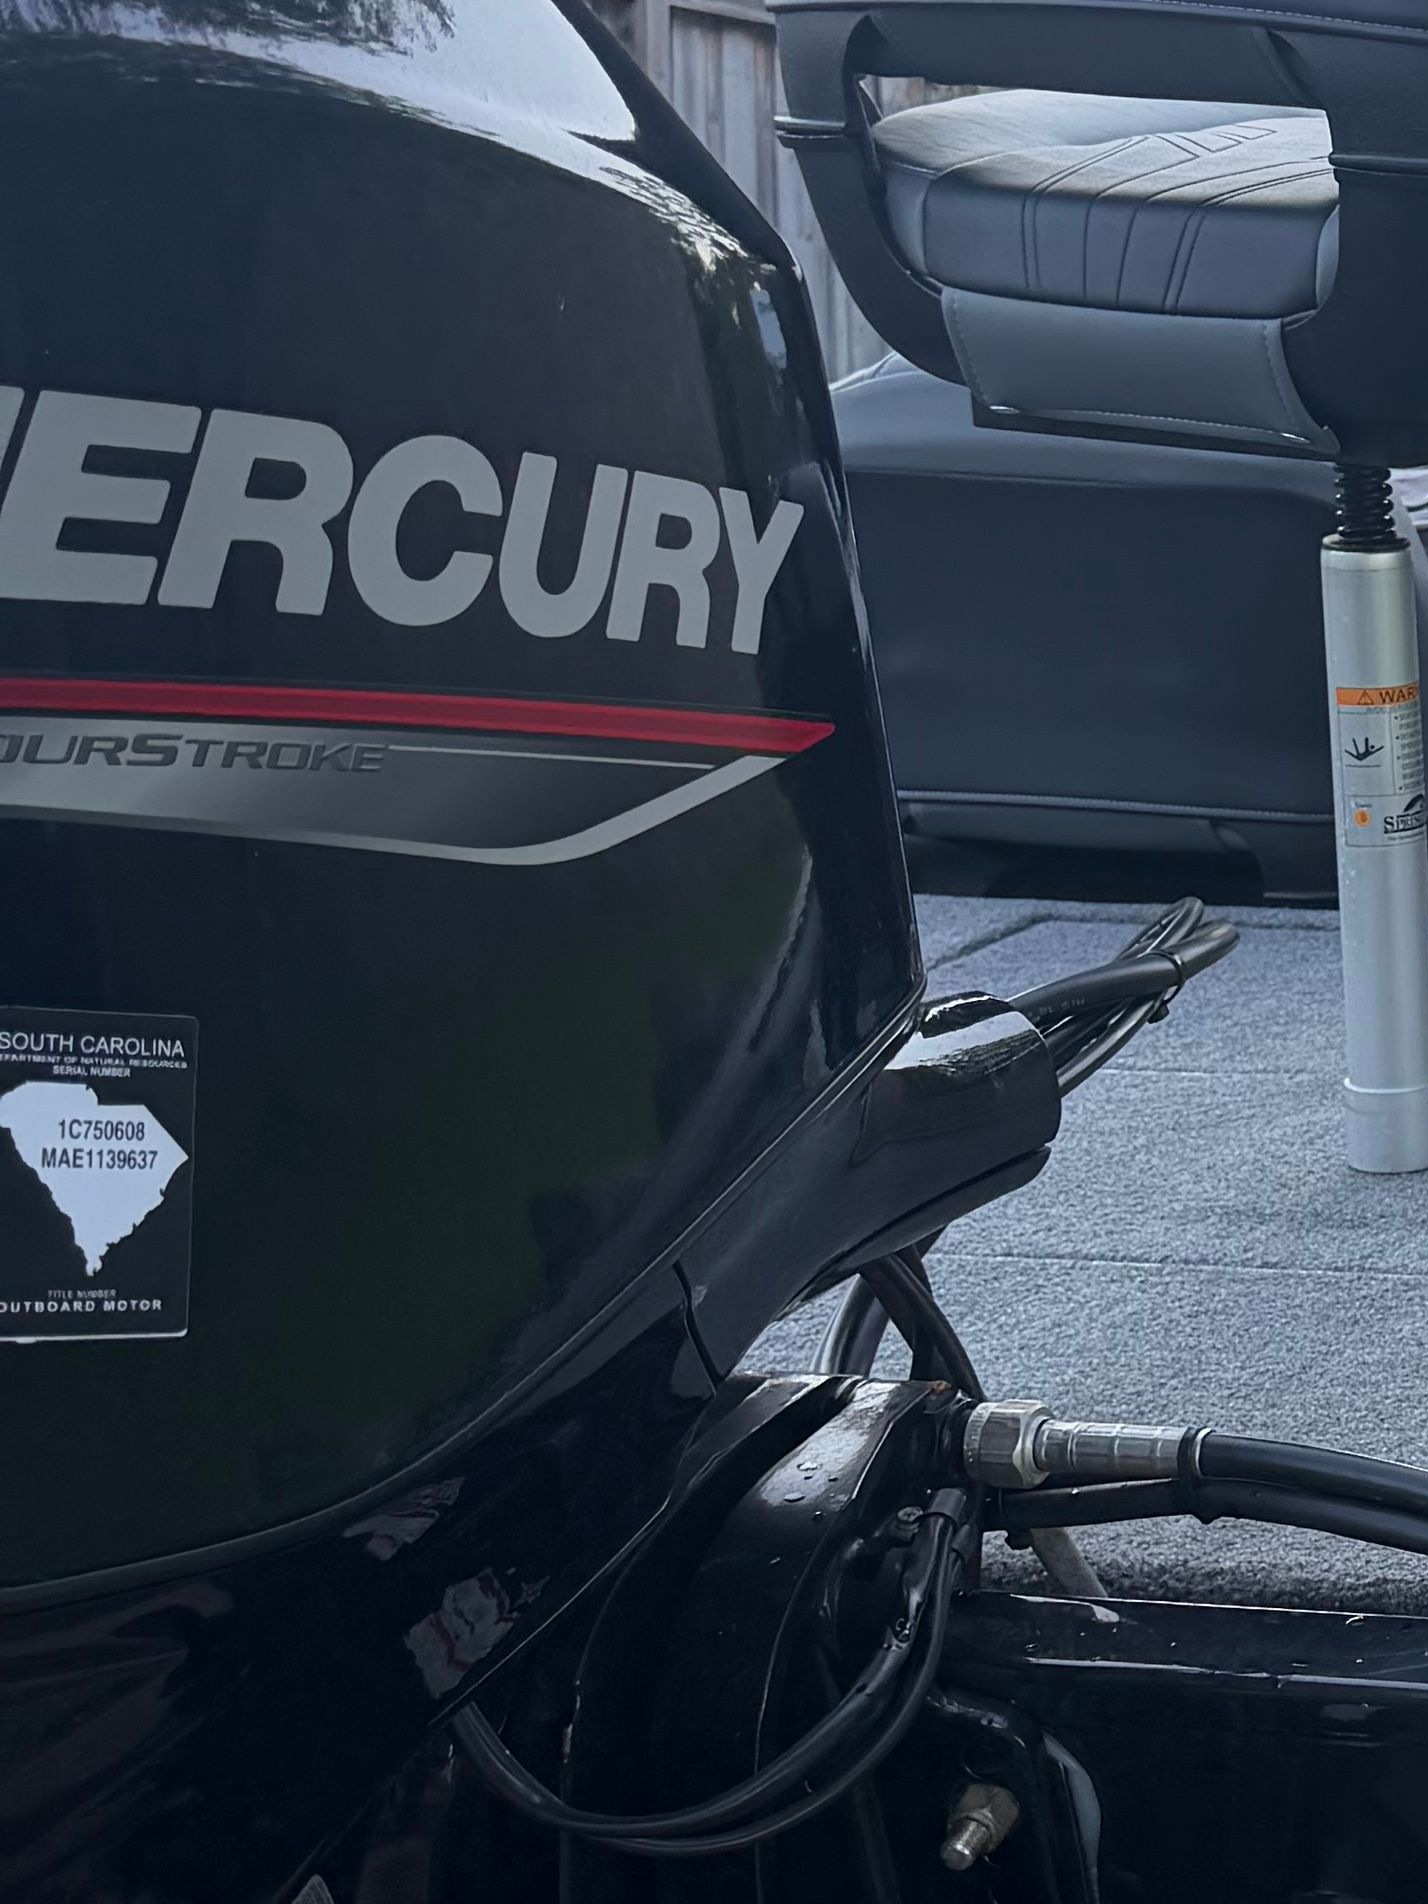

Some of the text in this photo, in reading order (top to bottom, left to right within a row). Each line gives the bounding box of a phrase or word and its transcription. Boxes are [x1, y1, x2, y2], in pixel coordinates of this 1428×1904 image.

[0, 384, 804, 655] ERCURY
[0, 1031, 185, 1058] SOUTH CAROLINA
[53, 1064, 131, 1078] SERIAL NUMBER
[58, 1118, 145, 1141] 1C750608
[41, 1147, 158, 1170] MAE1139637
[48, 1288, 117, 1299] TITLE NUMBER
[0, 1299, 163, 1313] OUTBOARD MOTOR
